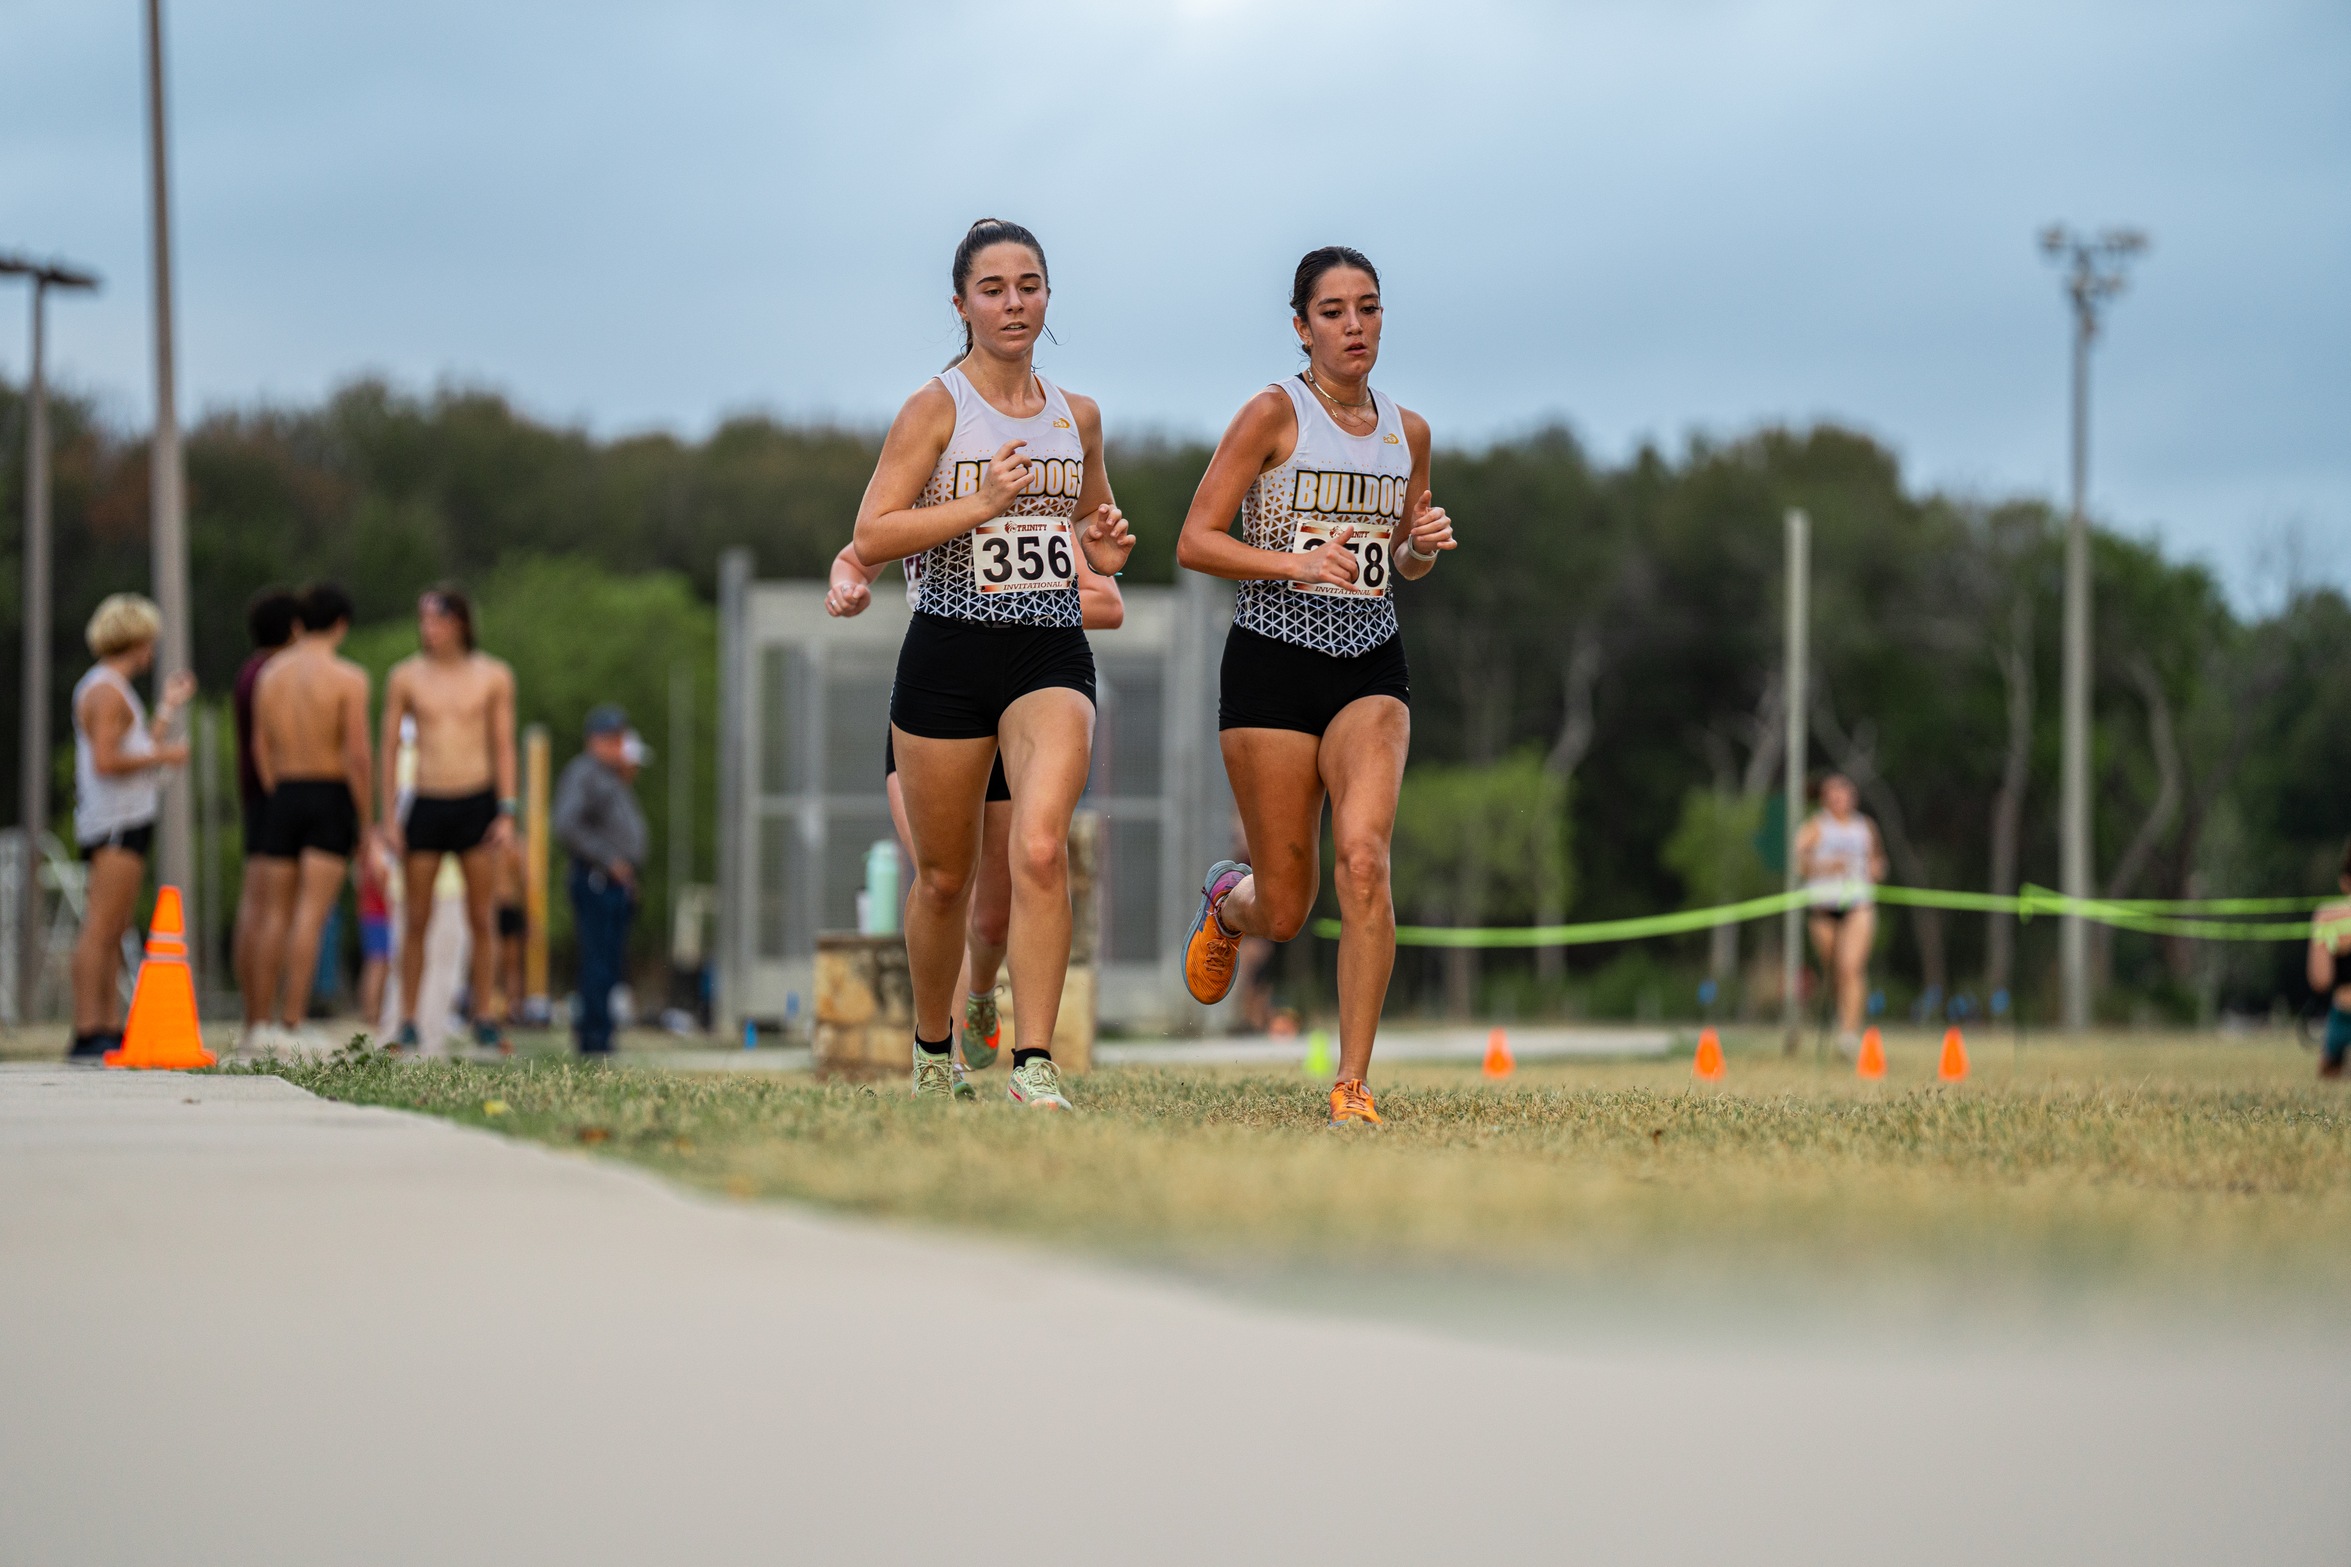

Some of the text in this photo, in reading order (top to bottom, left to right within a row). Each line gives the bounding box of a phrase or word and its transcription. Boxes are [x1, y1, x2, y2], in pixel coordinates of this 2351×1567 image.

[1292, 470, 1408, 520] BULLDOG
[1017, 523, 1047, 532] TRINITY
[982, 535, 1072, 583] 356
[1003, 581, 1063, 591] INVITATIONAL
